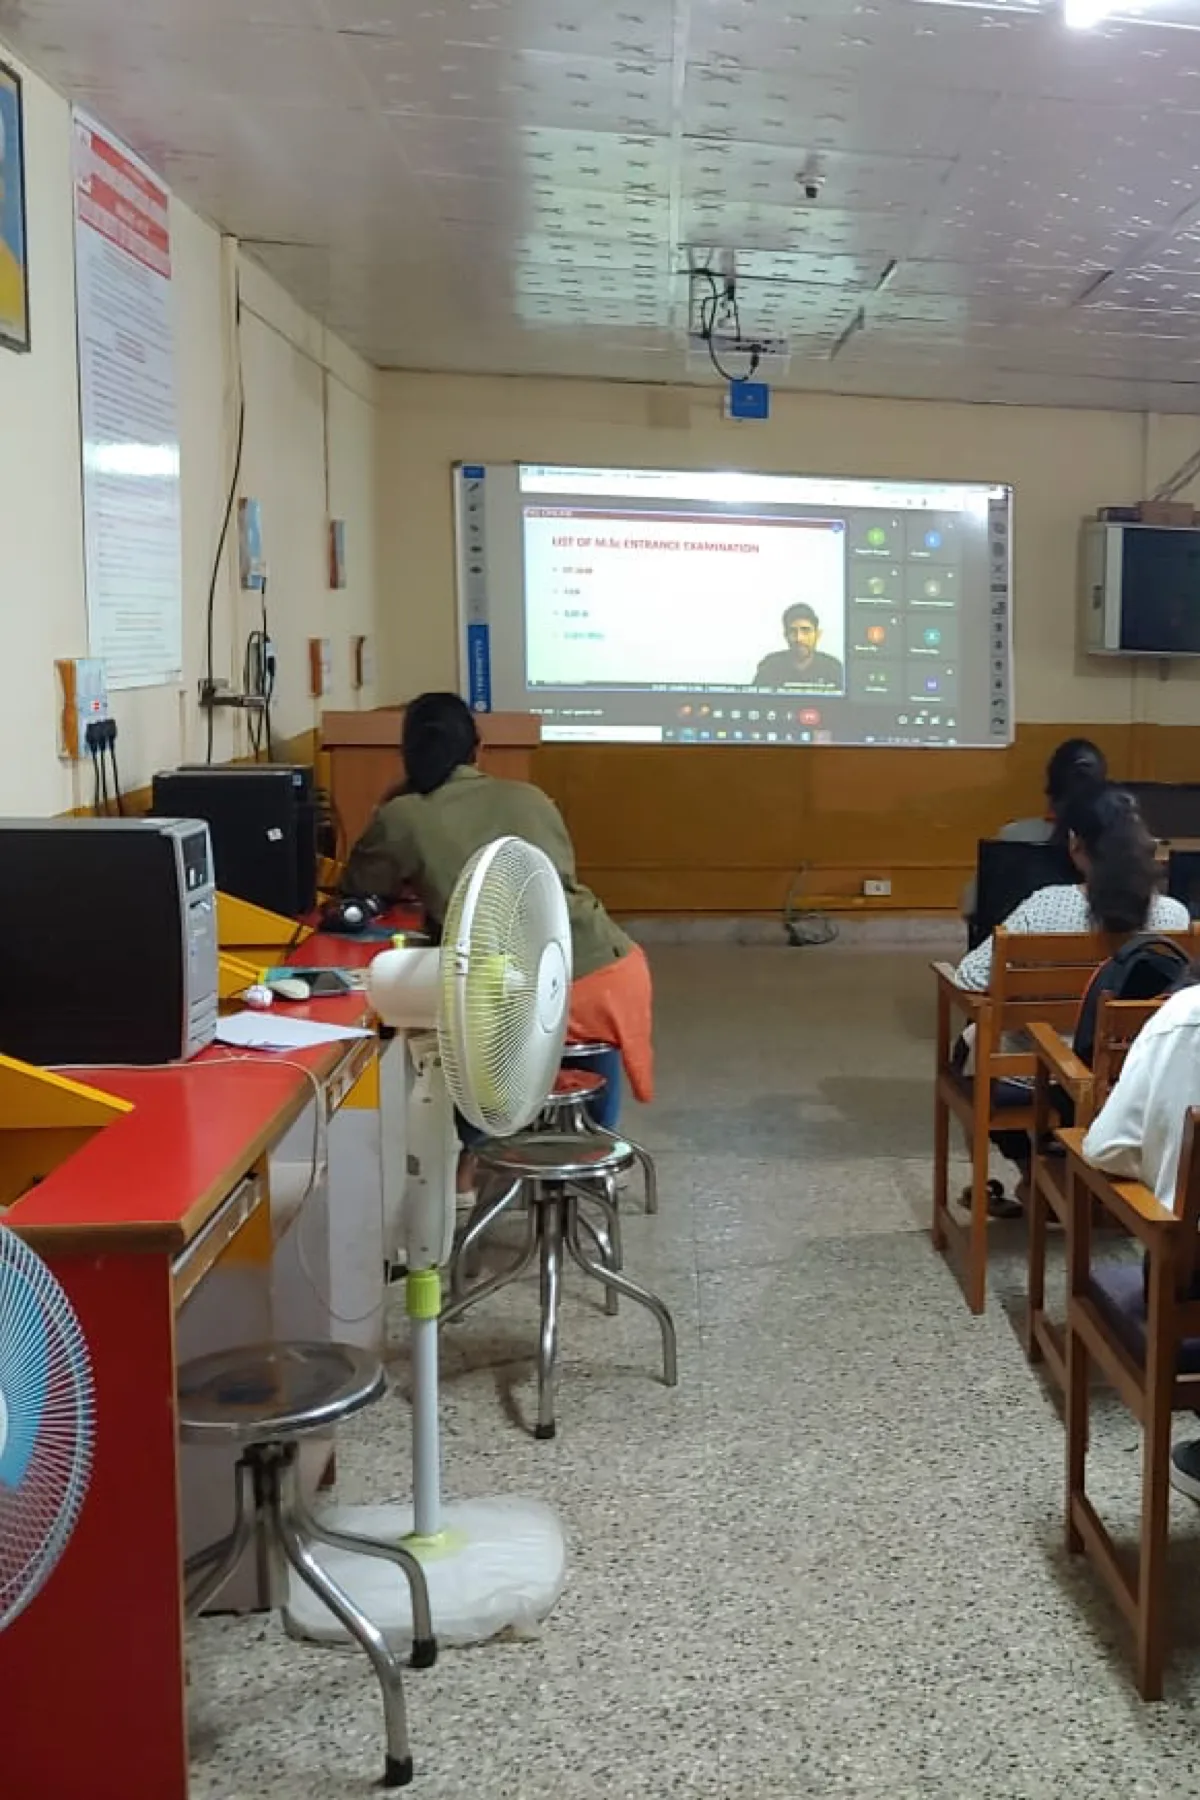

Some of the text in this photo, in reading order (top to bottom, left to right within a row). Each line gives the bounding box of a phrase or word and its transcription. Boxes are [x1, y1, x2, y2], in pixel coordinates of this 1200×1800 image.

[552, 536, 573, 547] LIST
[577, 537, 591, 548] OF
[624, 538, 680, 551] ENTRANCE
